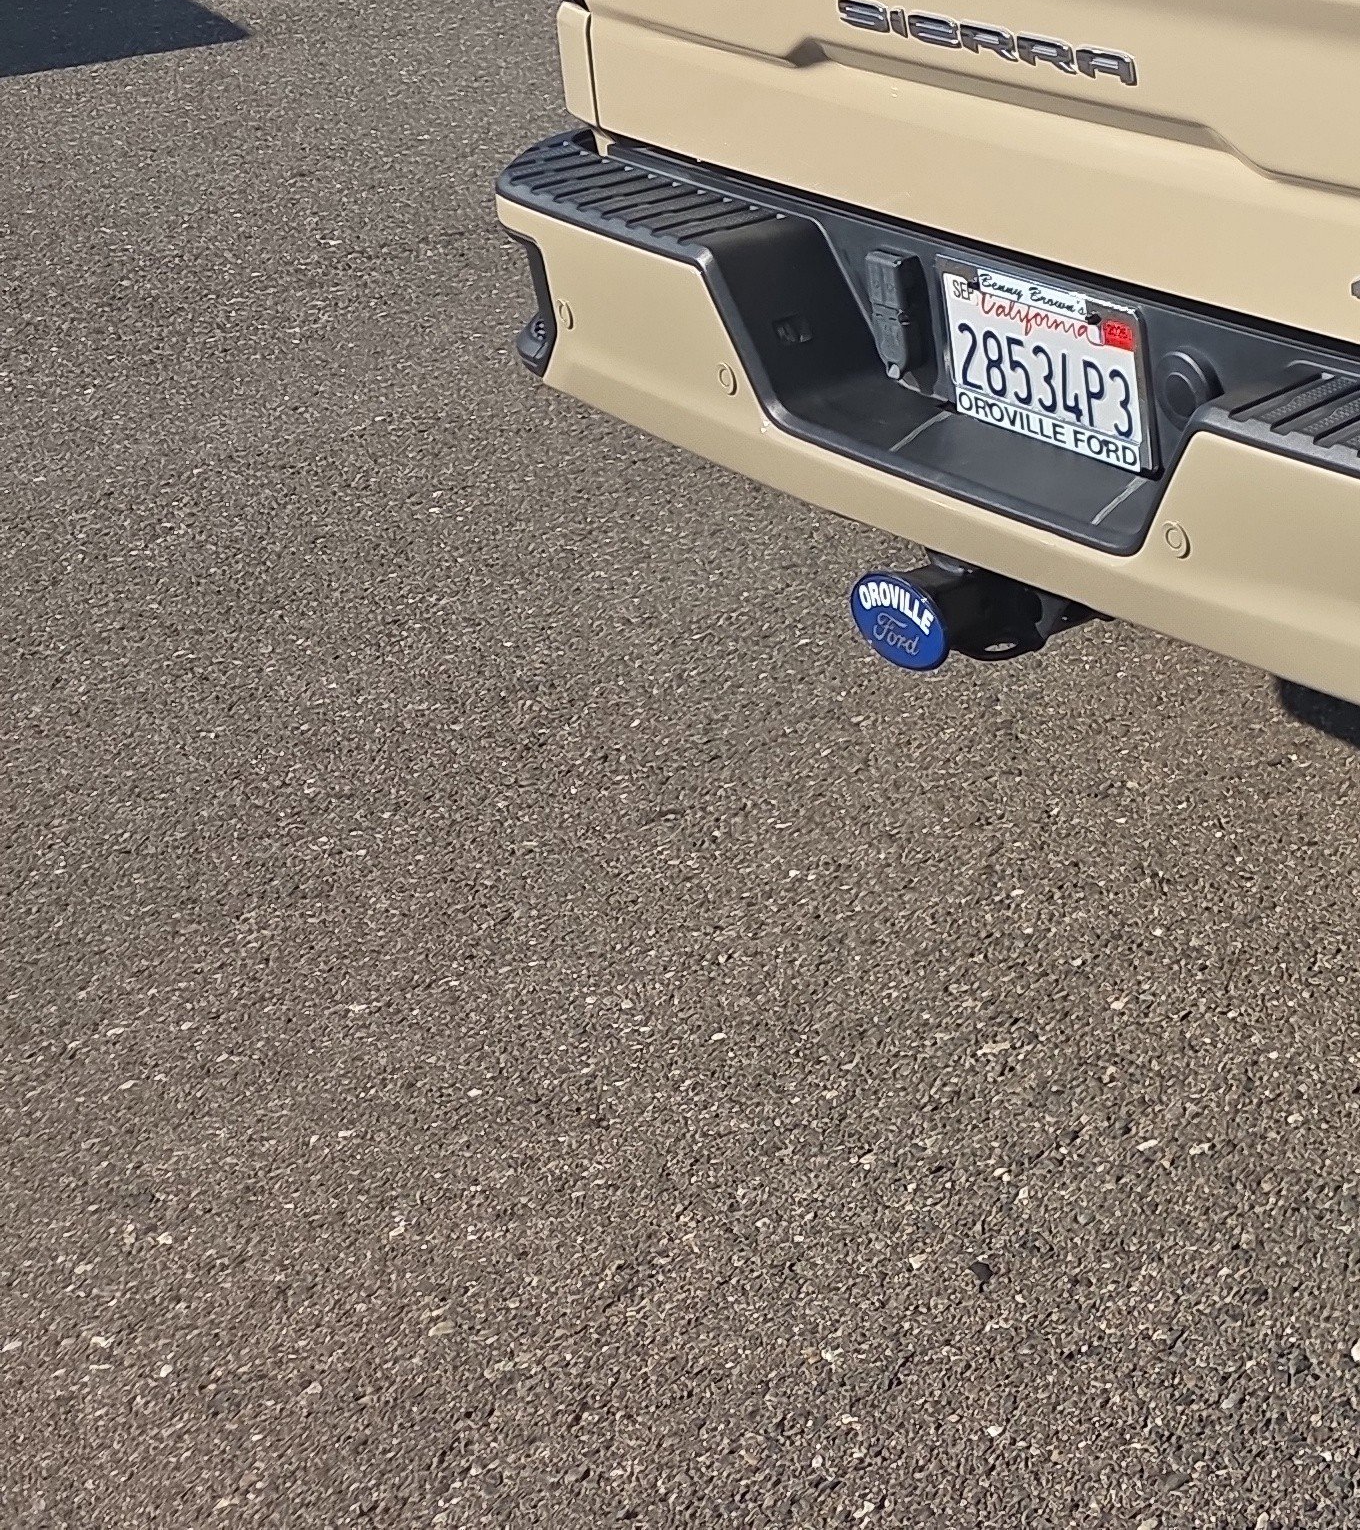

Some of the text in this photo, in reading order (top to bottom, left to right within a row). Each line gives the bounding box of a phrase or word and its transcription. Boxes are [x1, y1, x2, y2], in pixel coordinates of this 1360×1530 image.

[979, 273, 1086, 316] Benny Brown's
[981, 292, 1101, 345] California
[957, 322, 1134, 439] 28534P3
[958, 390, 1138, 468] OROVILLE FORD
[858, 581, 935, 636] OROVILLE
[873, 612, 920, 656] Ford
